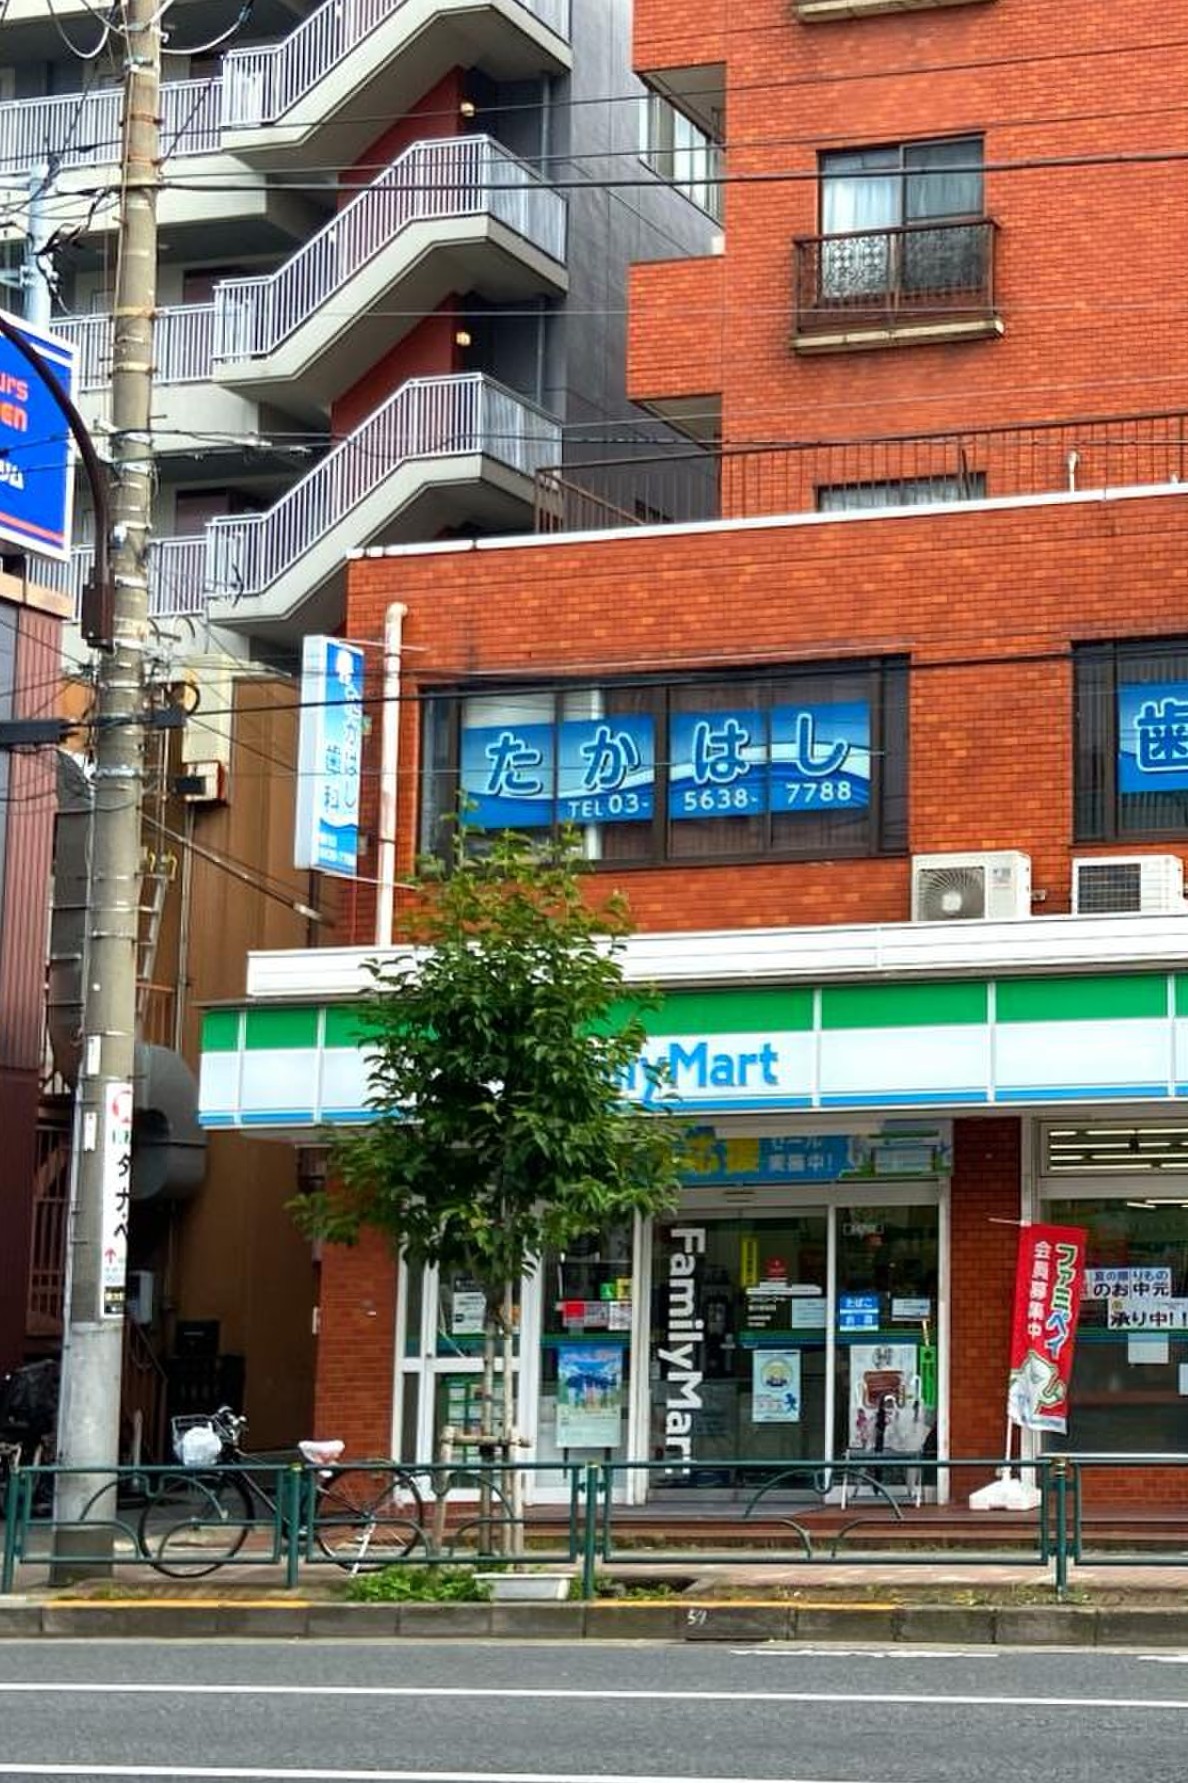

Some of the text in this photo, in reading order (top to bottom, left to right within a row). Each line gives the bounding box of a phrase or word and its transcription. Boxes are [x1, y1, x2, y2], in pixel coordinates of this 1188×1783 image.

[485, 713, 851, 796] たかはし
[568, 801, 602, 818] TEL
[1045, 1243, 1077, 1359] ファミペイ
